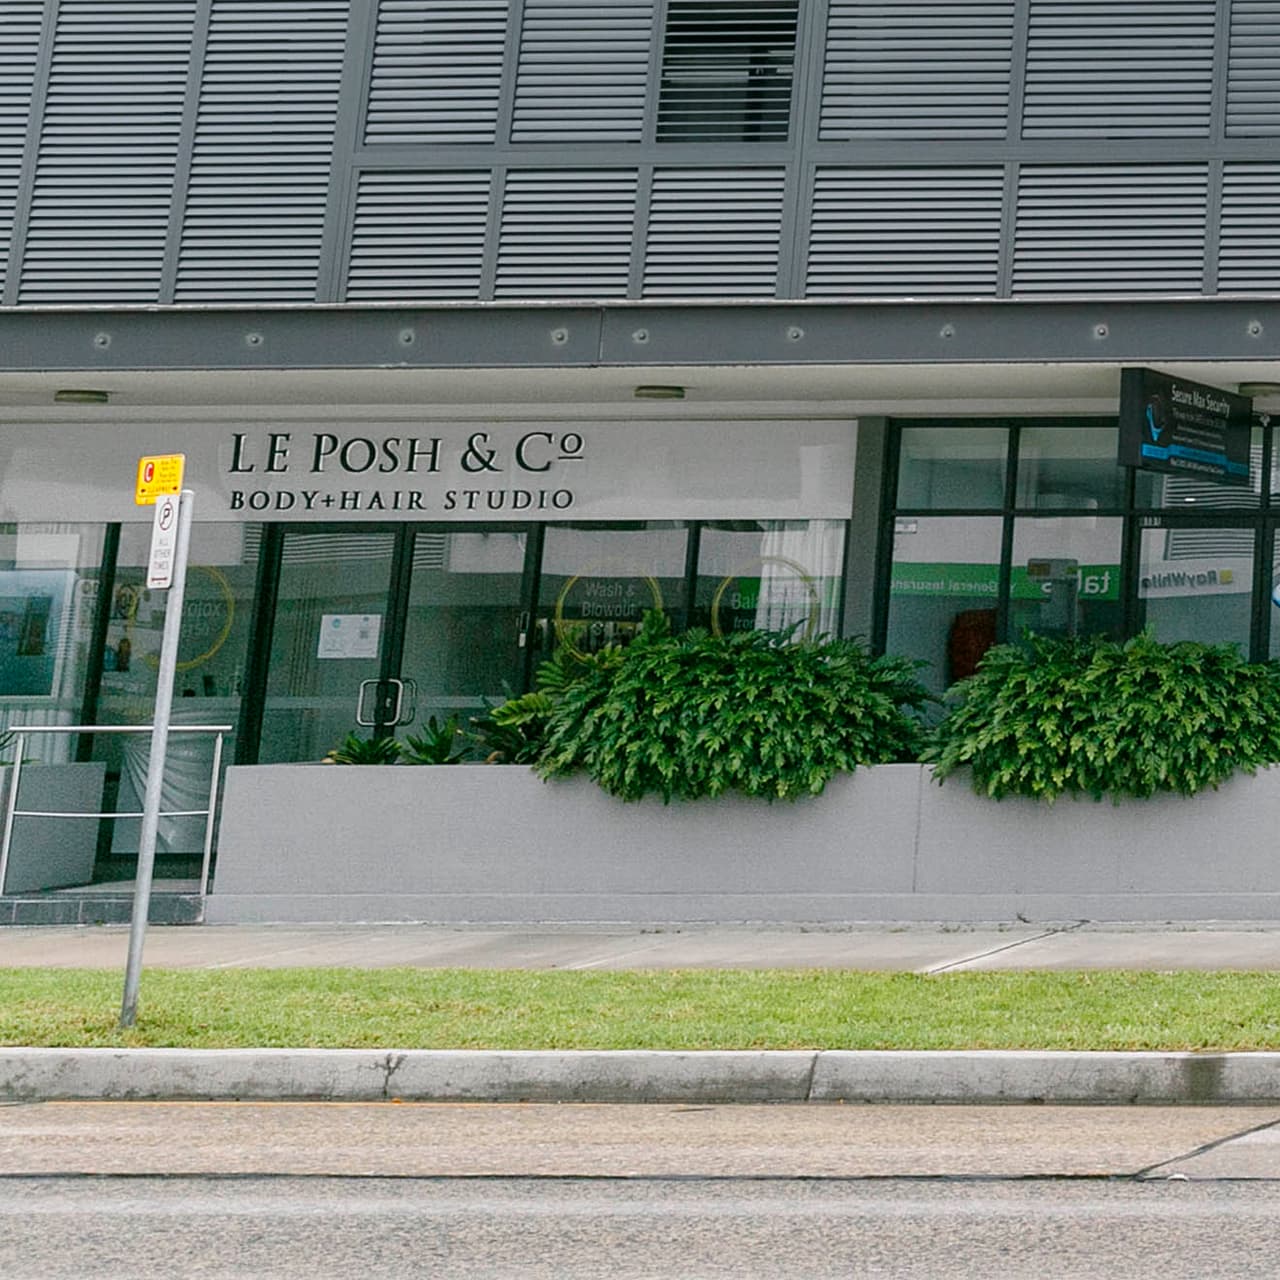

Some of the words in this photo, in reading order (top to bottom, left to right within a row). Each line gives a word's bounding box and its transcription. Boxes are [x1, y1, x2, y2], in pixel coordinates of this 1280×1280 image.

[1171, 383, 1193, 406] Secure
[1206, 393, 1230, 419] Security
[228, 432, 292, 473] LE
[310, 432, 442, 473] POSH
[460, 431, 503, 473] &
[229, 489, 427, 511] BODY+HAIR
[443, 488, 574, 510] STUDIO
